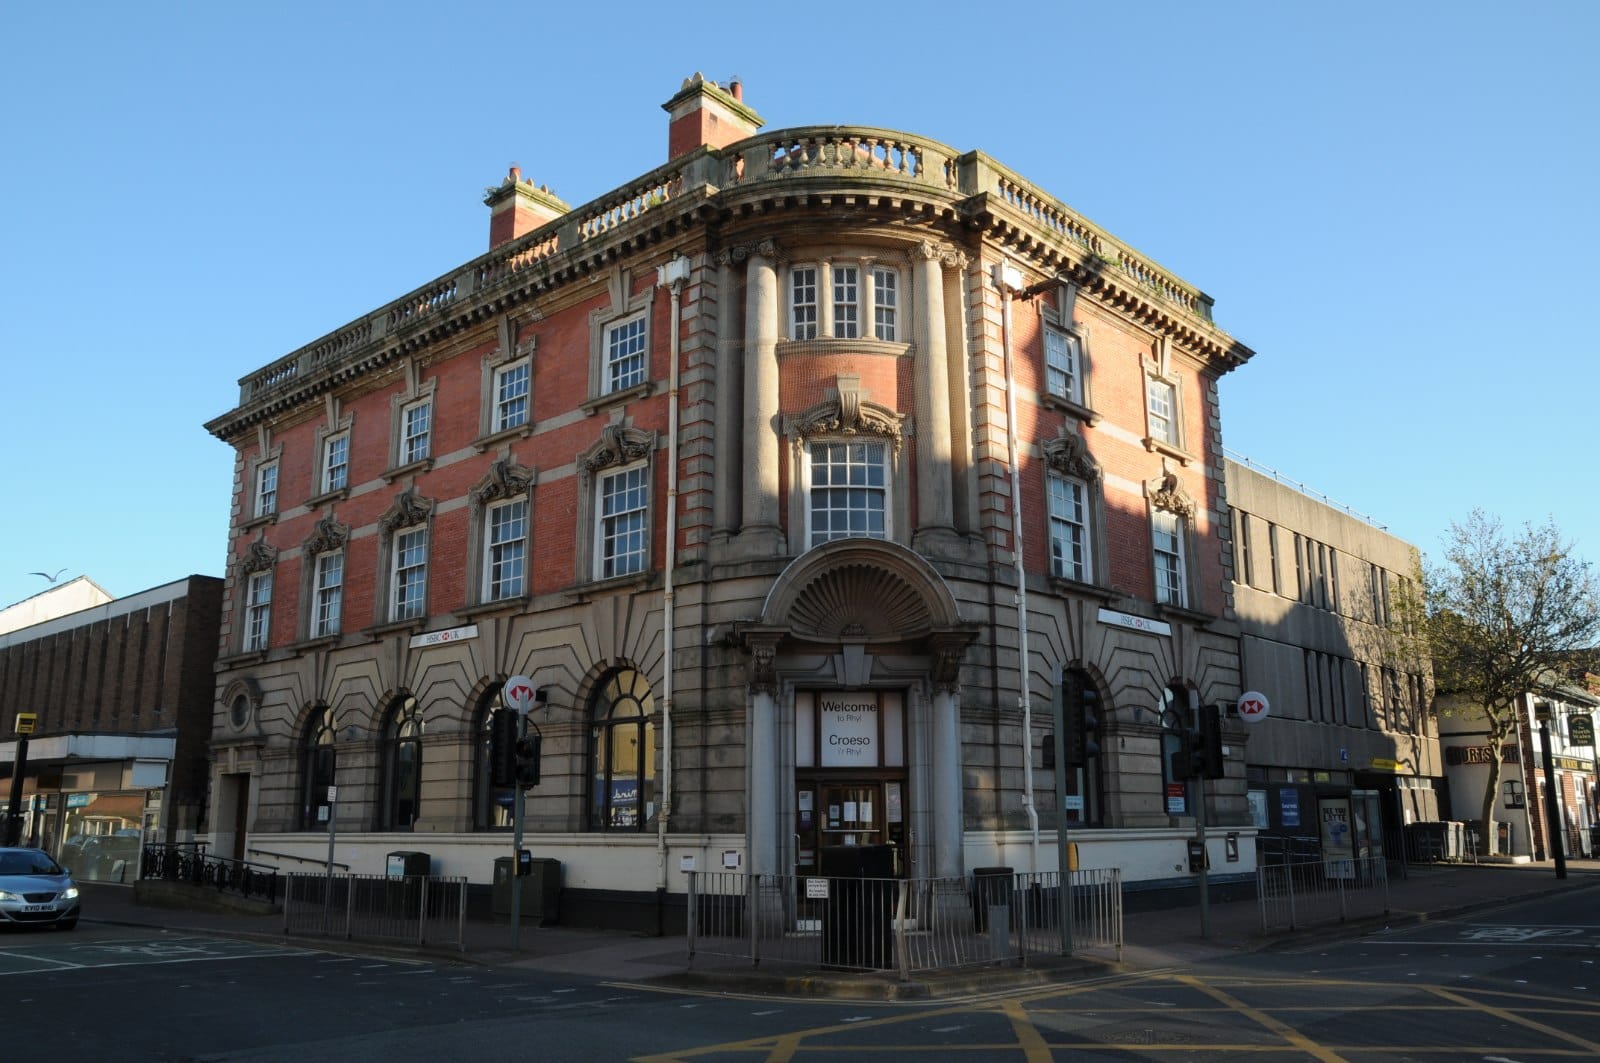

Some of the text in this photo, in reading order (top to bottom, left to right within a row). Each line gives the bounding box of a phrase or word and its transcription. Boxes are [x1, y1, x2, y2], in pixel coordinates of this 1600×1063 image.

[1120, 615, 1135, 626] HSBC
[426, 631, 459, 643] HSBC UK
[822, 701, 877, 712] Welcome
[847, 714, 862, 723] Rhyl
[829, 734, 870, 746] Croeso
[847, 748, 862, 756] Rhyl
[1335, 807, 1346, 815] YOU
